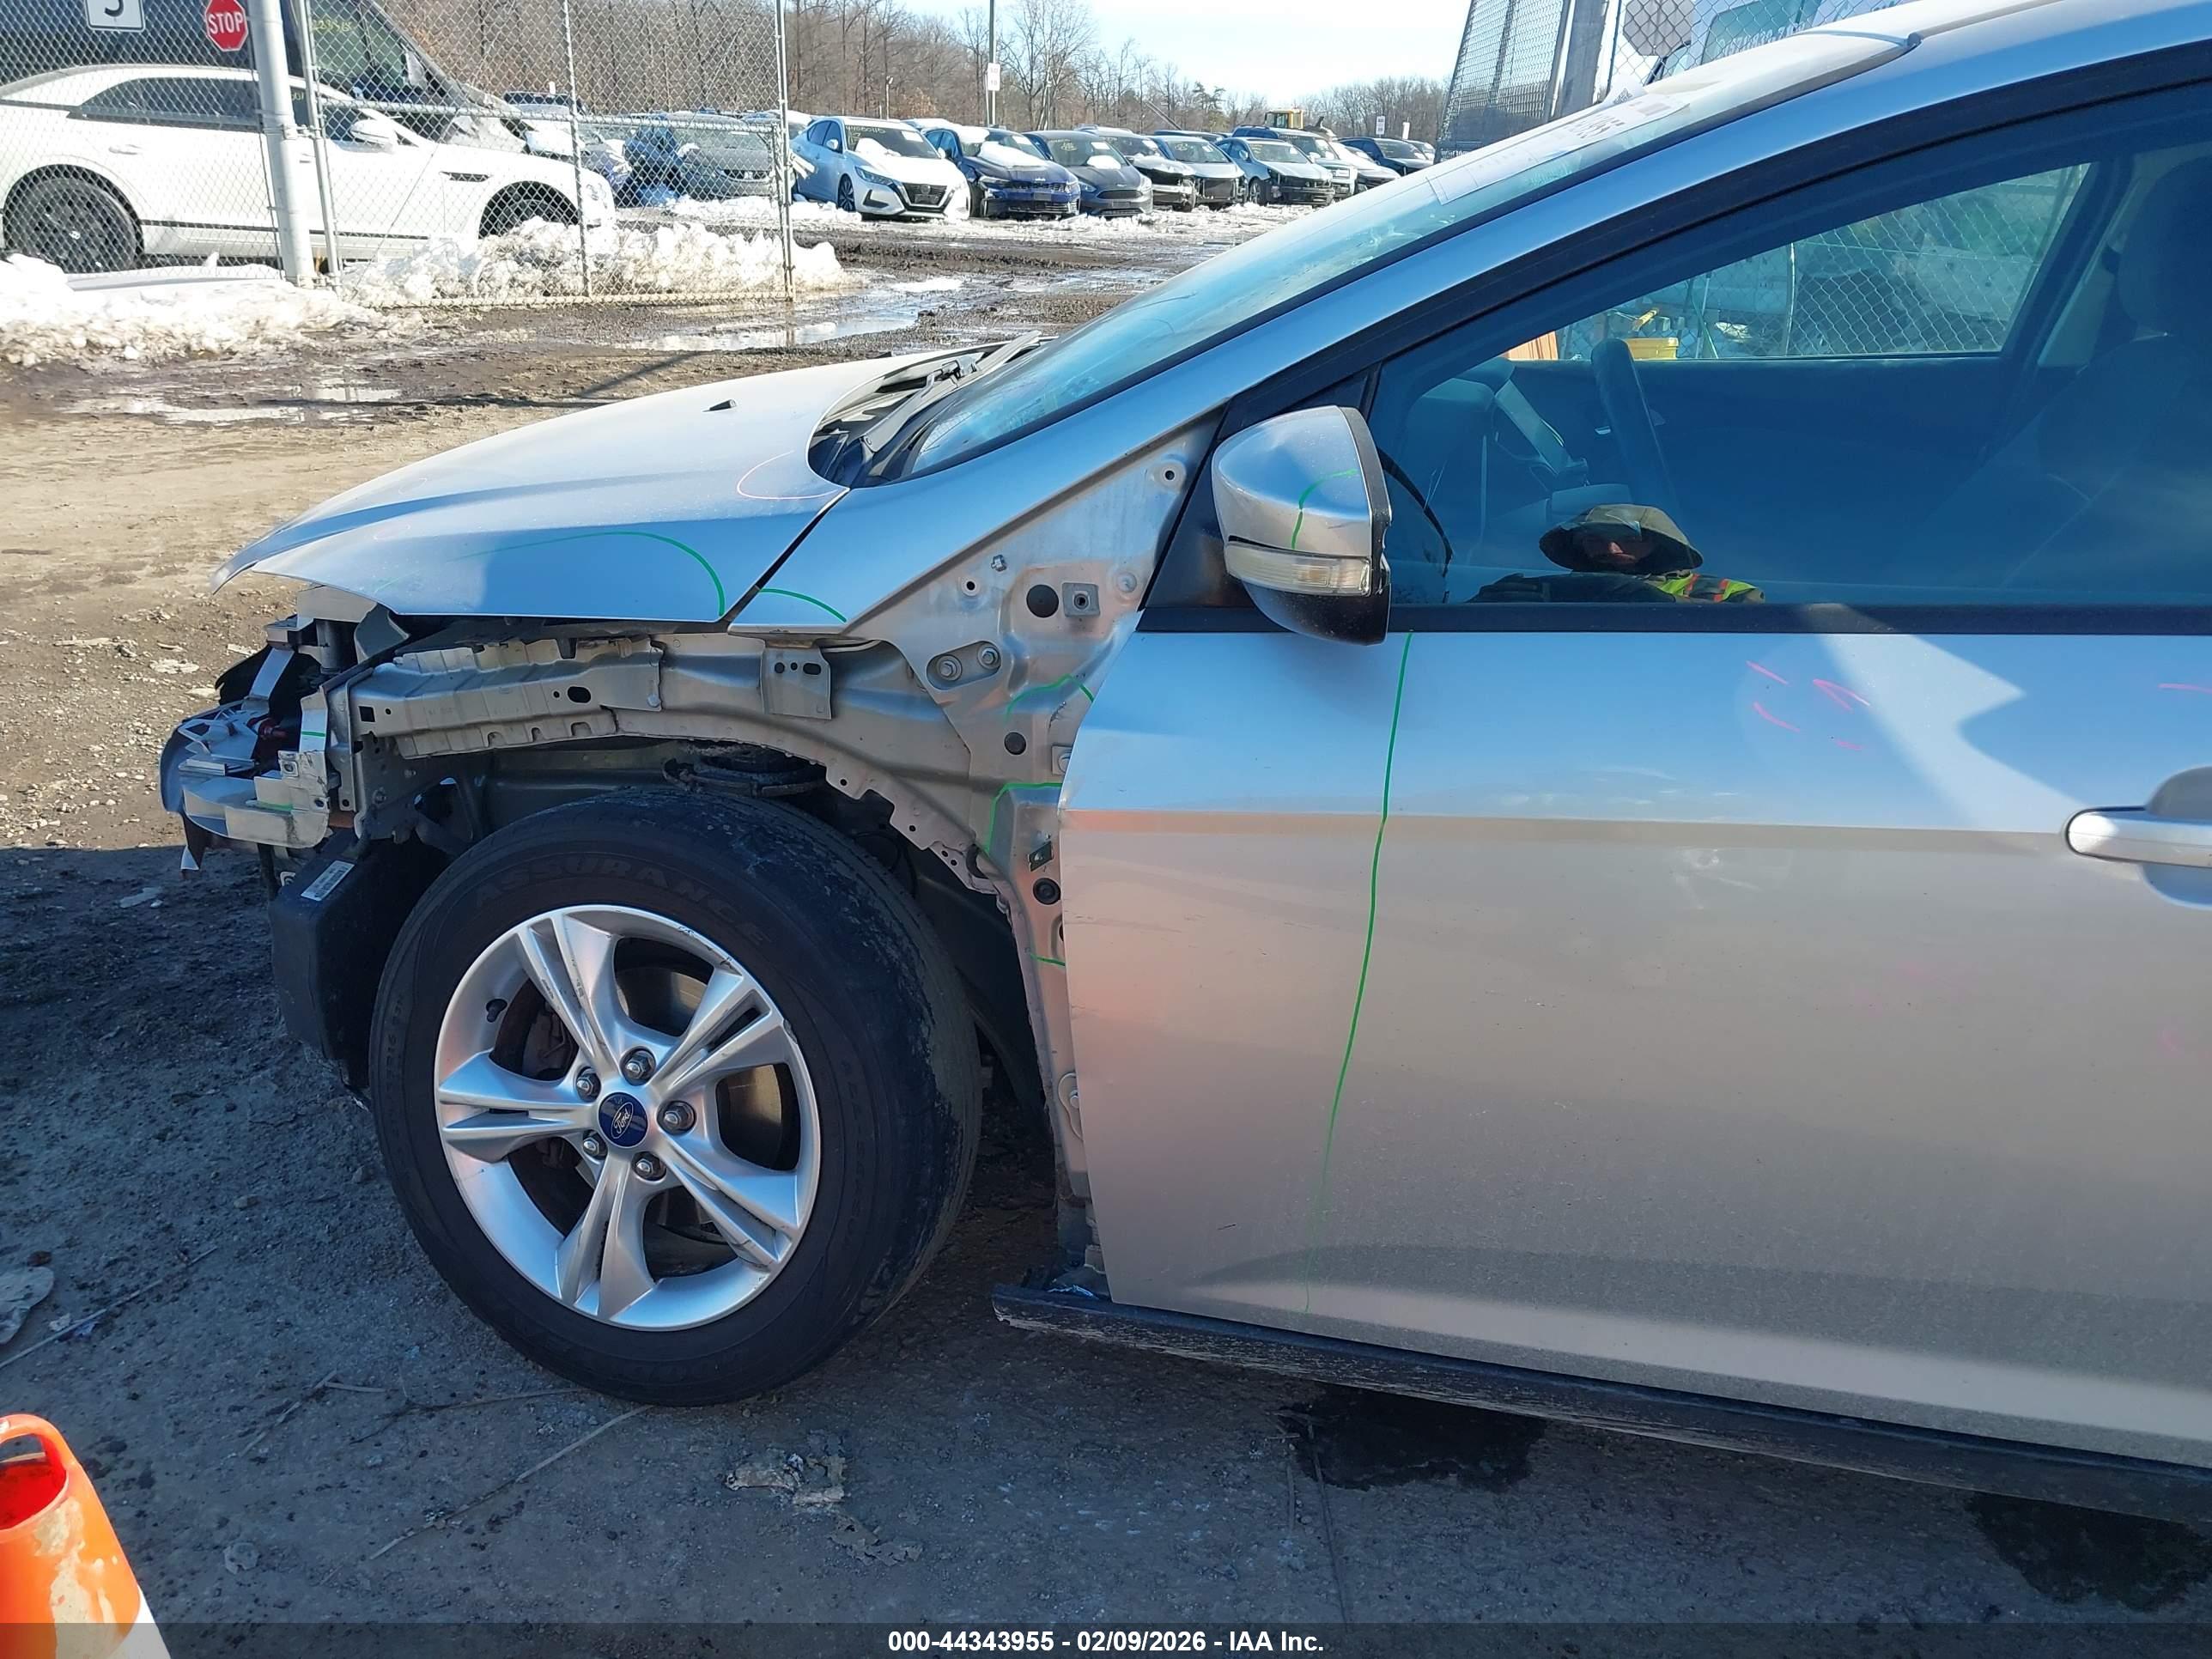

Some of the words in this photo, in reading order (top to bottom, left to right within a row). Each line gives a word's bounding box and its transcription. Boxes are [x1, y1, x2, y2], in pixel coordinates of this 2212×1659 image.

[208, 12, 245, 35] STOP
[476, 856, 775, 947] ASSURANCE
[613, 1107, 631, 1134] Ford
